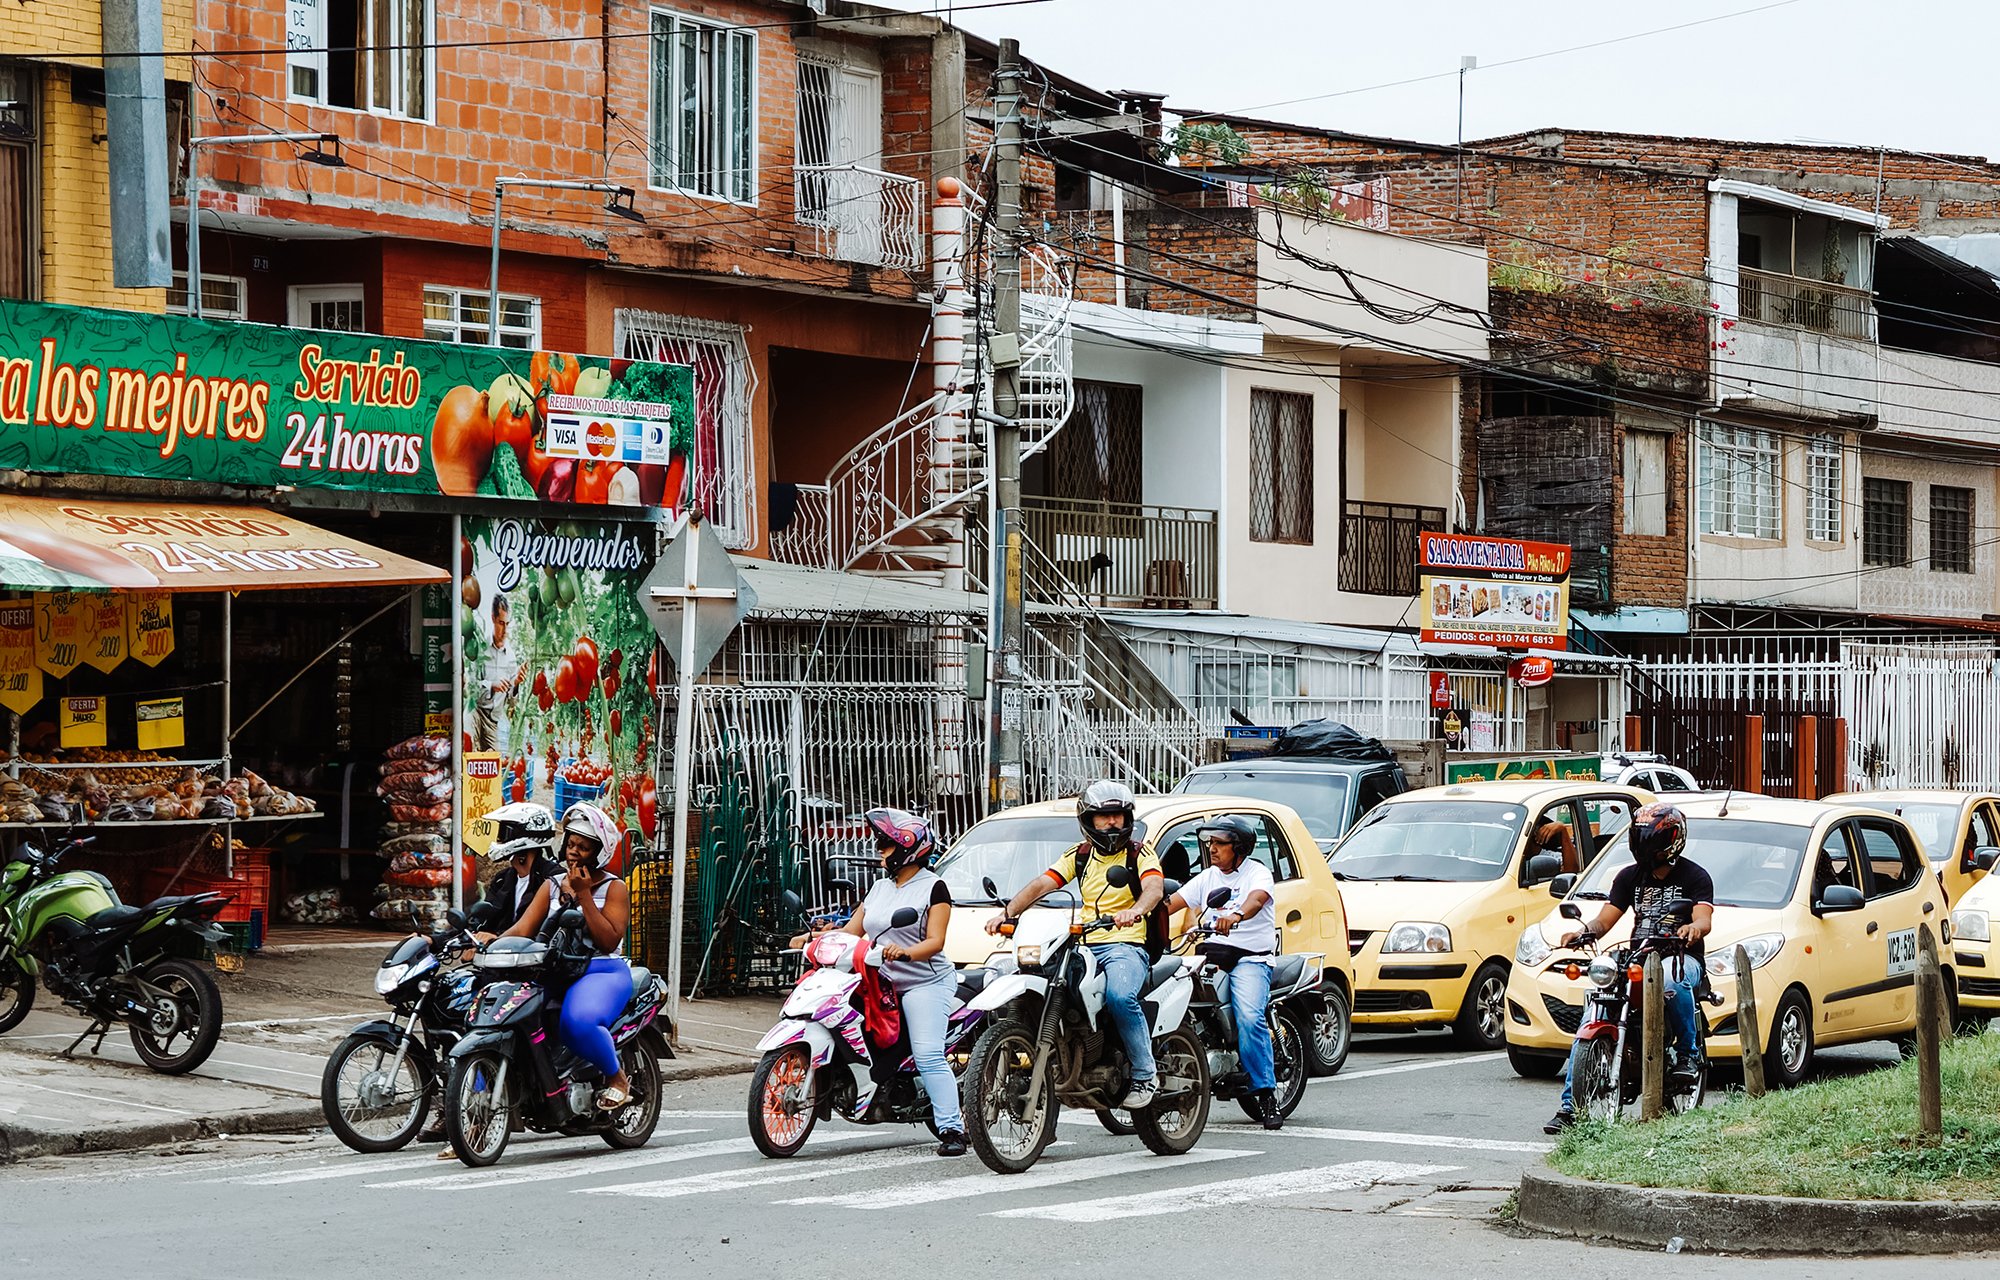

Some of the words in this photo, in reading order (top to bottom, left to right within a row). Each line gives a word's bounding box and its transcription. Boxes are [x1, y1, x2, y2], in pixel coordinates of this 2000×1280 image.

[293, 10, 305, 27] DE
[287, 31, 312, 51] ROPA
[295, 344, 421, 409] Servicio
[34, 338, 100, 427] los
[105, 353, 269, 458] mejores
[549, 396, 592, 411] RECIBIMOS
[594, 399, 618, 413] TODAS
[620, 401, 634, 414] LAS
[634, 403, 670, 418] TARJETAS
[280, 414, 327, 468] 24
[329, 414, 423, 475] horas
[554, 429, 577, 445] VISA
[57, 505, 291, 538] Servicio
[119, 541, 232, 574] 24
[189, 541, 384, 574] horas
[495, 518, 644, 592] Bienvenidos
[1427, 537, 1525, 570] SALSAMENTARIA
[1556, 551, 1565, 573] 27
[1491, 572, 1508, 580] Venta
[1515, 573, 1533, 582] Mayor
[1538, 574, 1553, 583] Detal
[1434, 632, 1477, 642] PEDIDOS:
[1479, 633, 1493, 642] Cel
[1495, 634, 1511, 643] 310
[1514, 635, 1530, 643] 741
[1532, 635, 1554, 645] 6813
[428, 635, 439, 673] kikes
[1520, 661, 1547, 677] Zenú
[69, 699, 97, 711] OFERTA
[467, 761, 499, 776] OFERTA
[1651, 887, 1663, 907] NEW
[1662, 885, 1674, 908] YORK
[1673, 885, 1683, 899] ITY
[453, 984, 472, 994] Hero
